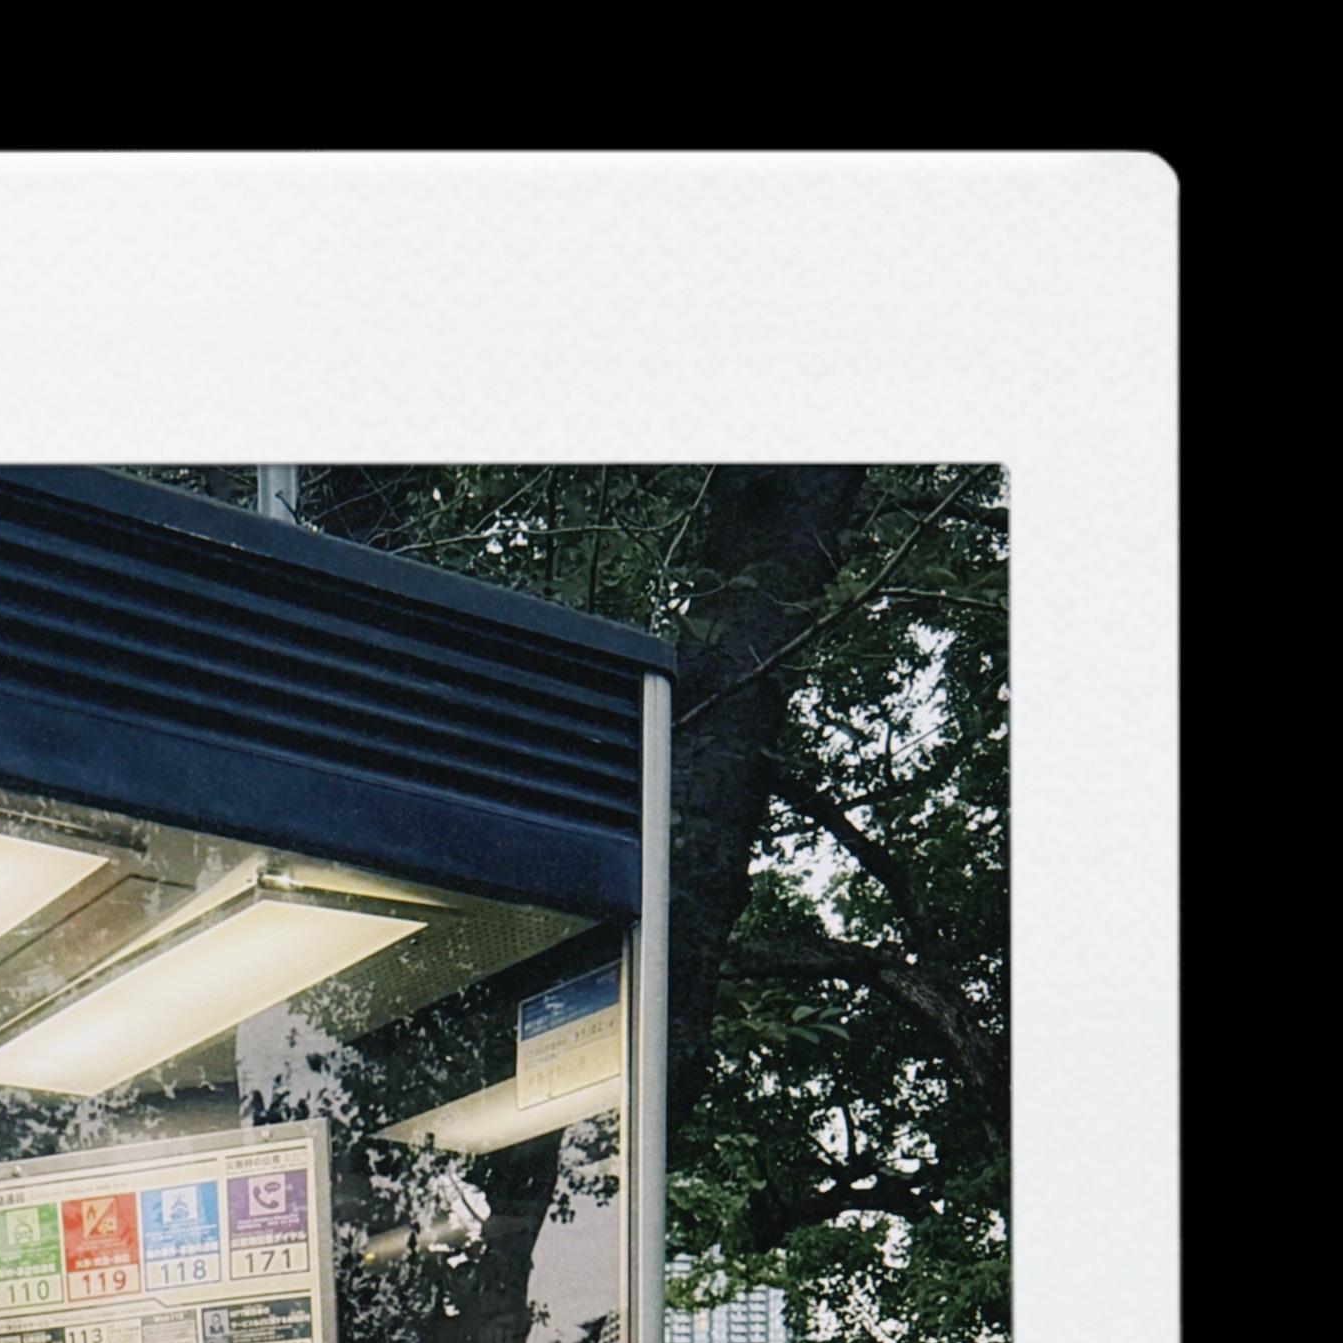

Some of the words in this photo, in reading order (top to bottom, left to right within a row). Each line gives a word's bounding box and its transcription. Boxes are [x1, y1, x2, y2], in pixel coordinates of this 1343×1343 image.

[161, 1258, 207, 1285] 118
[245, 1247, 293, 1274] 171
[7, 1279, 51, 1305] 110
[82, 1269, 127, 1295] 119
